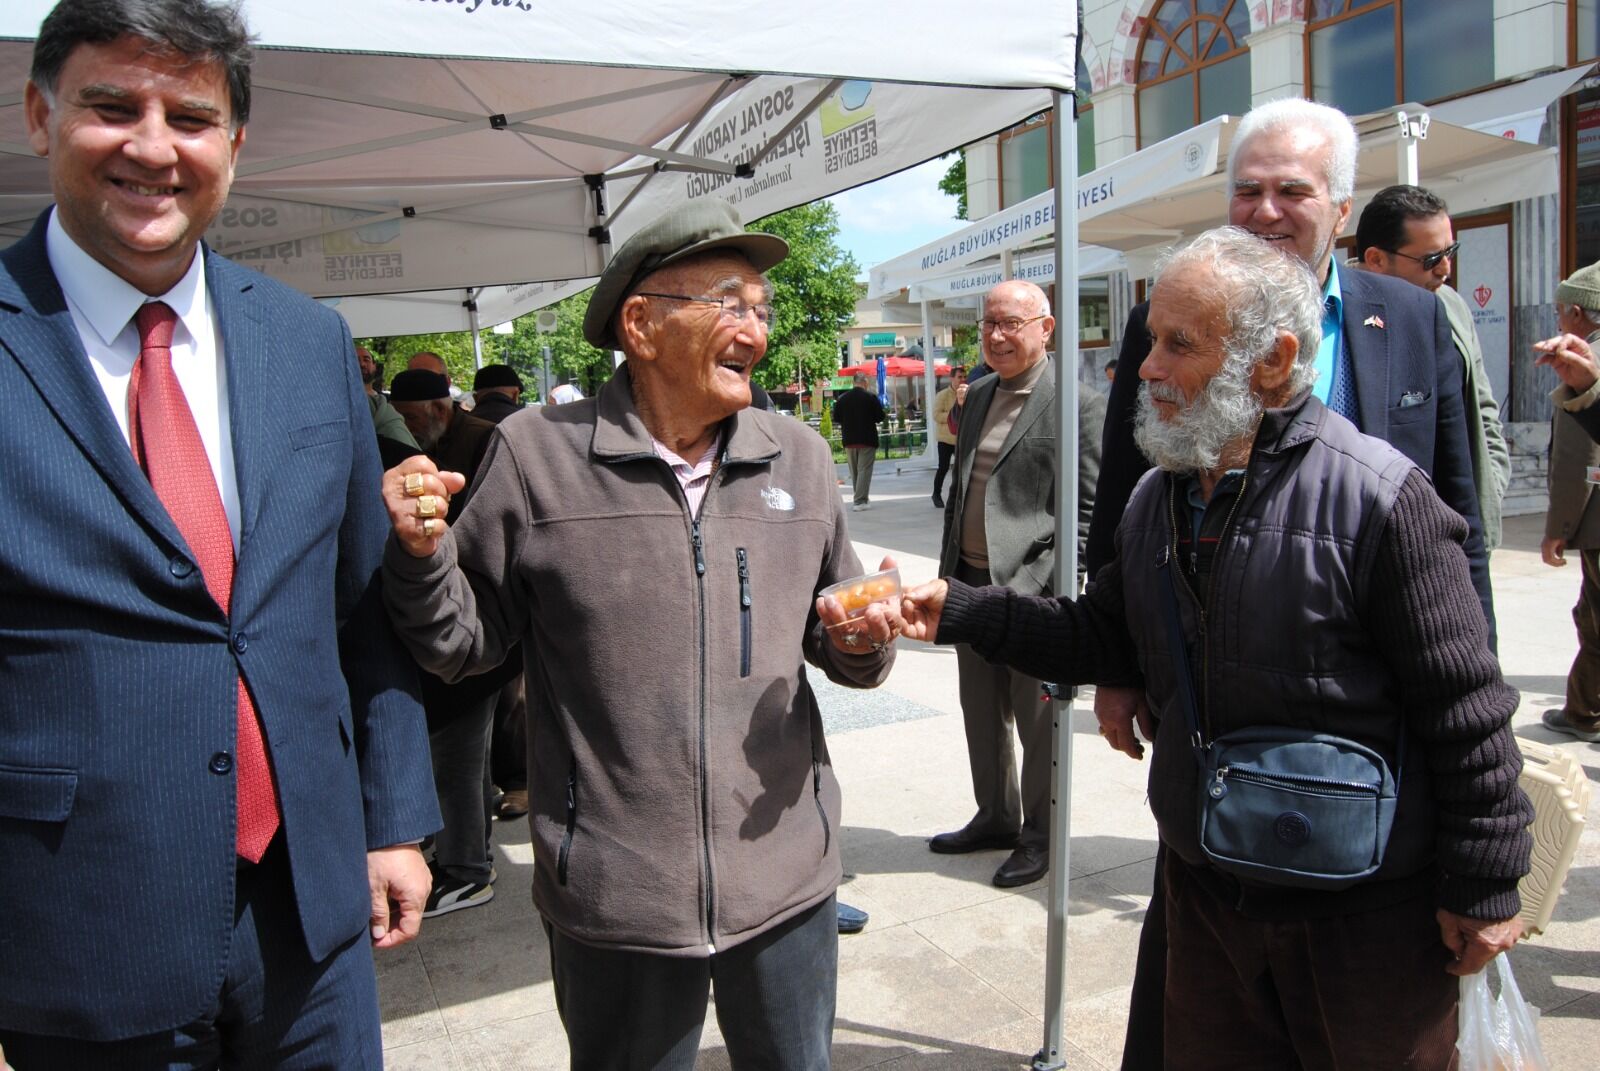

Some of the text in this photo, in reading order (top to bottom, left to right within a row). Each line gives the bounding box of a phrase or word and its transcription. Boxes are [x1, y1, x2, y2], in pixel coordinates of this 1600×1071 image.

[921, 177, 1114, 271] MUĞLA BÜYÜKŞEHİR BELİYESİ
[950, 263, 1054, 291] MUĞLA BÜYÜKHİR BELED
